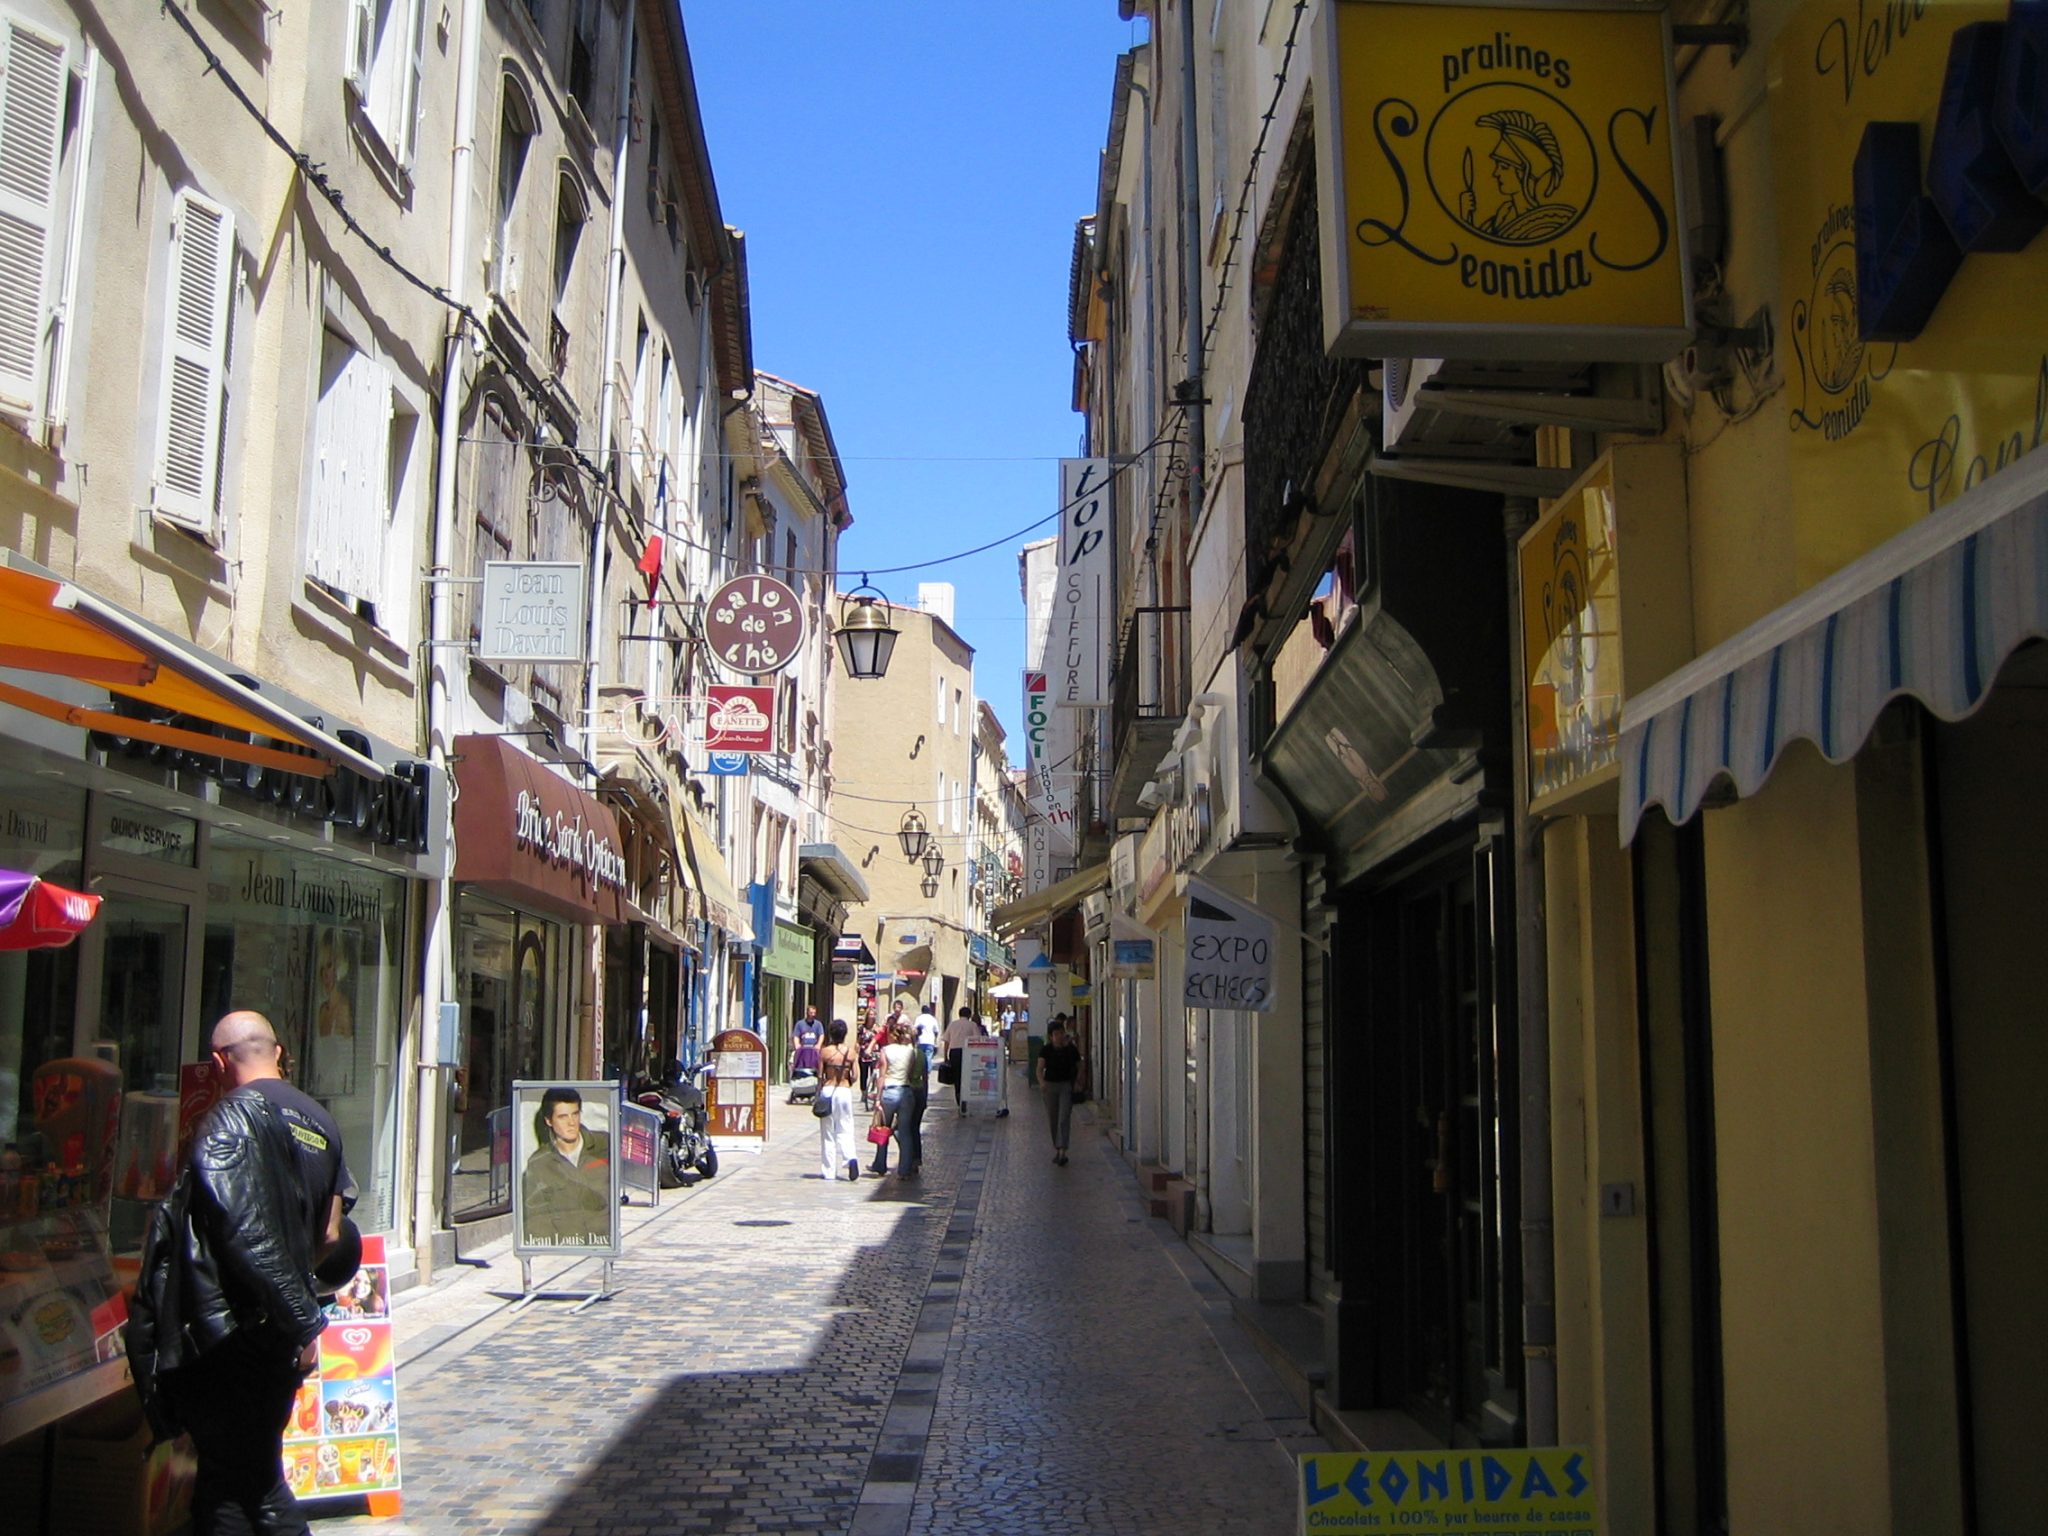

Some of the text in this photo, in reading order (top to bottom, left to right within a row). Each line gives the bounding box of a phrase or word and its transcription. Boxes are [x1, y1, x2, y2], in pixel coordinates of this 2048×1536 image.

[1442, 32, 1571, 93] pralines
[1069, 464, 1104, 566] top
[504, 566, 564, 594] Jean
[497, 597, 568, 626] Louis
[715, 579, 793, 626] salon
[740, 615, 767, 634] de
[1066, 572, 1082, 701] COIFFURE
[494, 627, 567, 655] David
[1040, 764, 1055, 802] PHOTO
[1048, 802, 1061, 811] en
[1048, 809, 1072, 825] 1h
[7, 808, 48, 844] David
[110, 816, 182, 850] QUICK SERVICE
[241, 859, 285, 907] Jean
[289, 869, 335, 914] Louis
[339, 880, 381, 922] David
[1190, 935, 1268, 965] EXPO
[1185, 972, 1266, 1002] ECHECS
[525, 1233, 552, 1246] Jean
[554, 1232, 586, 1246] Louis
[1303, 1452, 1590, 1507] LEONIDAS
[1308, 1507, 1591, 1527] Chocolats 100% pur beurre de cacao
